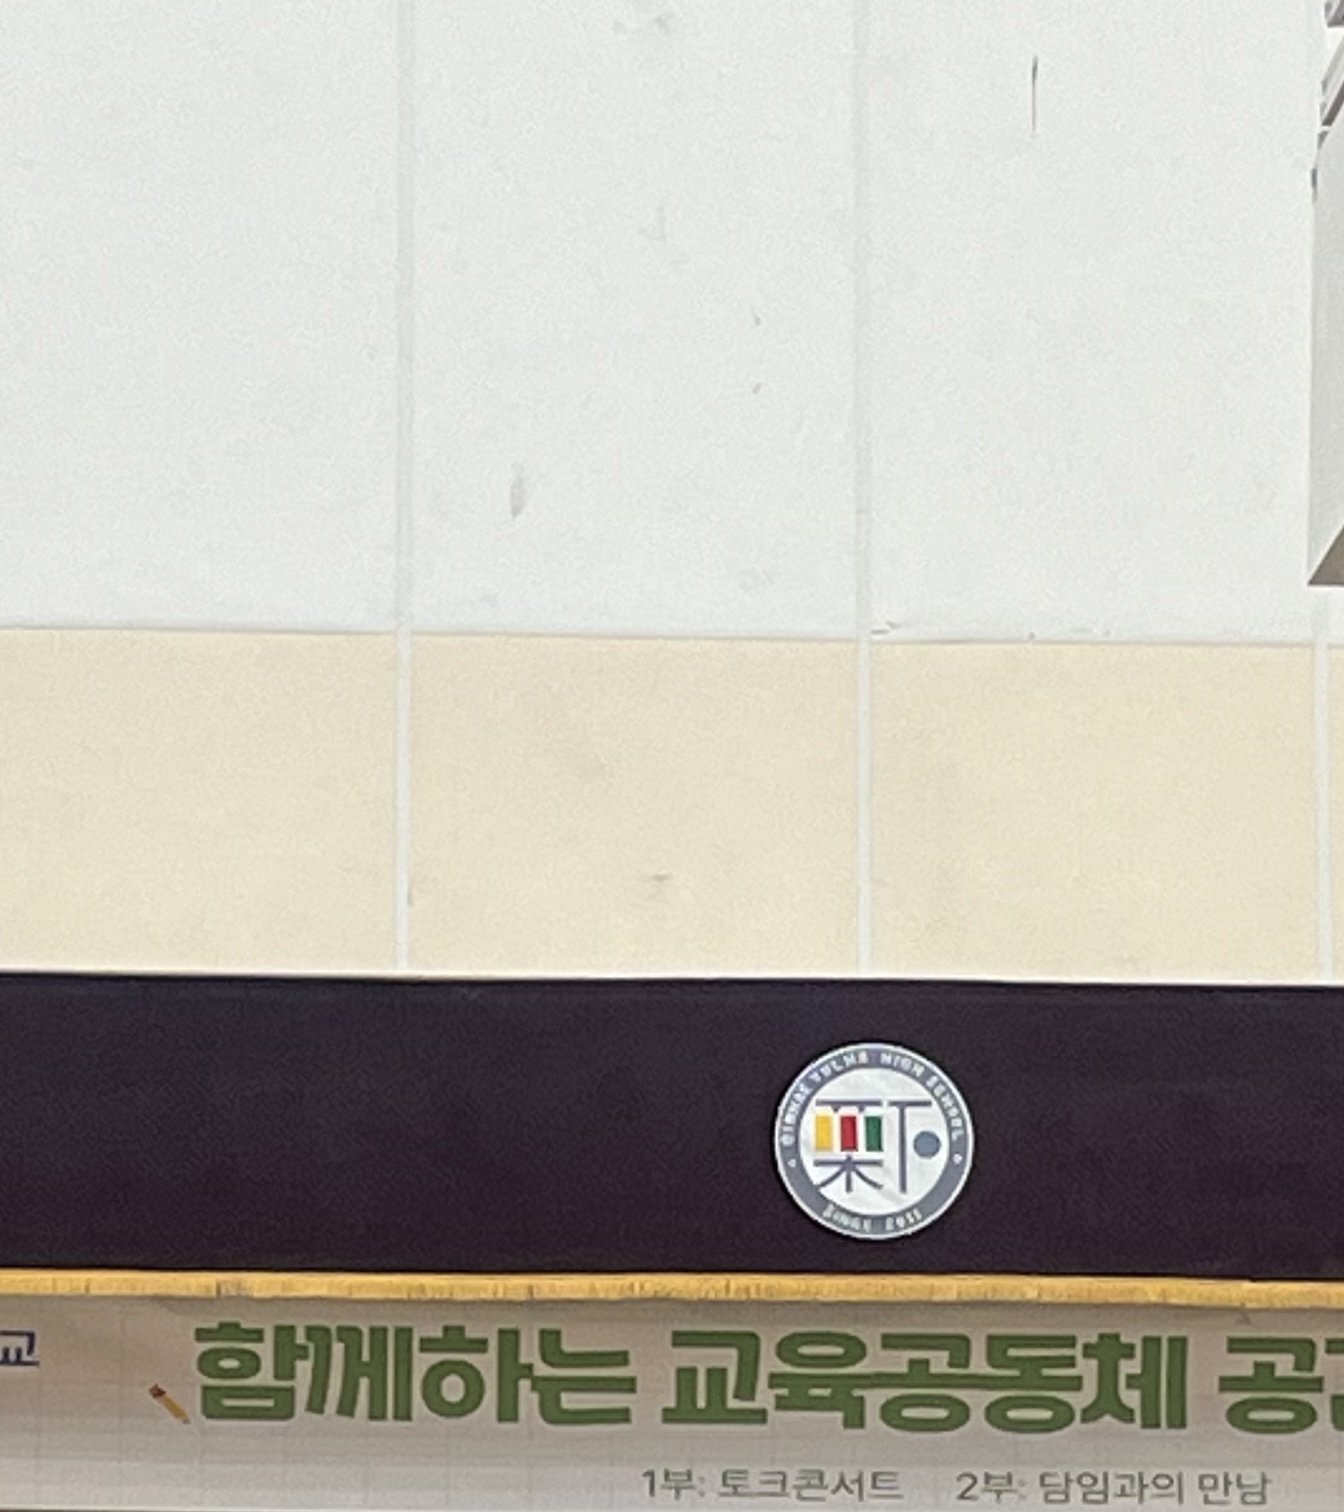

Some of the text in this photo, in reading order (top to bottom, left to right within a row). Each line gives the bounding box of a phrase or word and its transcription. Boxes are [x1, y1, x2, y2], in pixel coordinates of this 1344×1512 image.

[194, 1320, 638, 1425] 함께하는
[661, 1329, 1188, 1434] 교육공동체
[641, 1468, 1273, 1506] 1부: 토크콘서트 2부: 담임과의 만남
